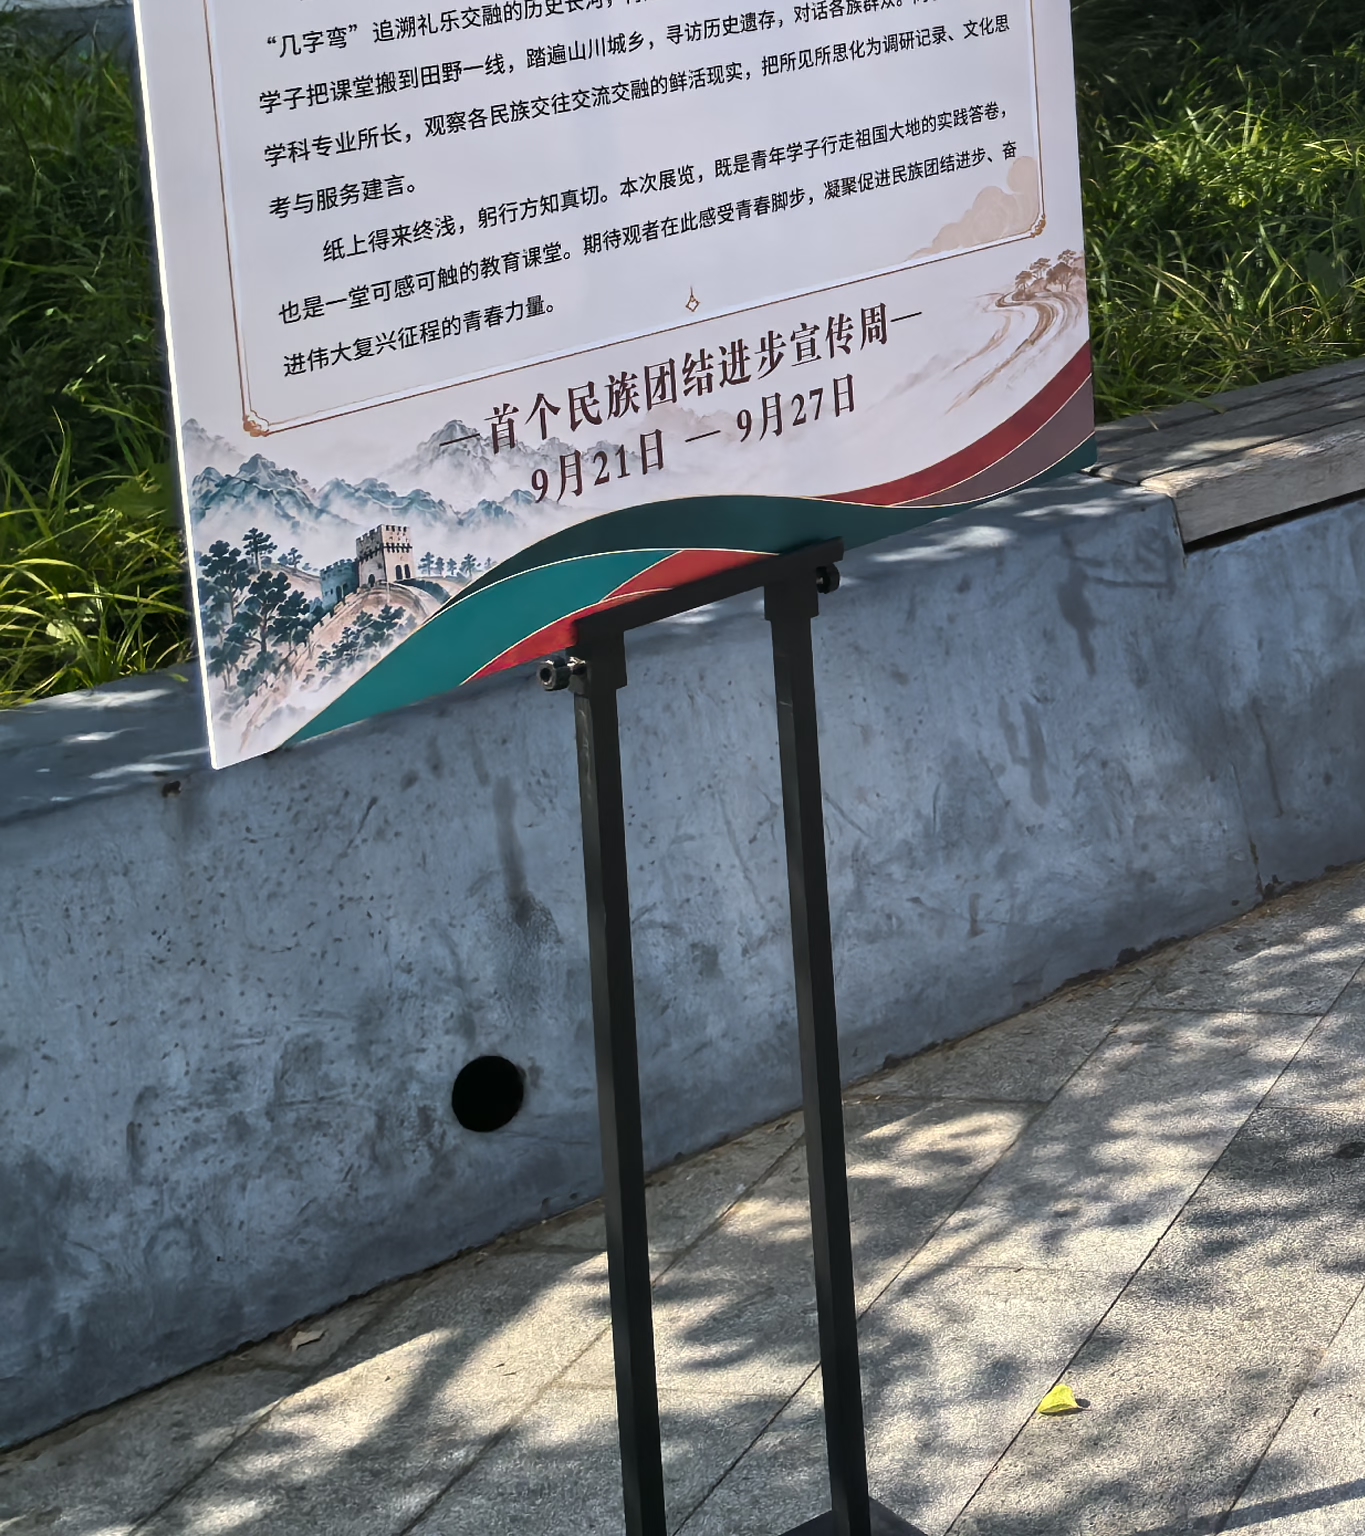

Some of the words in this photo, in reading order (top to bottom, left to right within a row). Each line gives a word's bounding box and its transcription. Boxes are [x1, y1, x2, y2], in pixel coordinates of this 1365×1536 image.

[264, 10, 1012, 171] 学科专业所长，观察各民族交往交流交融的鲜活现实，把所见所思化为调研记录、文化思
[268, 174, 417, 219] 考与服务建言。
[279, 138, 1018, 329] 也是一堂可感可触的教育课堂。期待观者在此感受青春脚步，凝聚促进民族团结进步、奋
[322, 101, 1006, 263] 纸上得来终浅，躬行方知真切。本次展览，既是青年学子行走祖国大地的实践答卷，
[283, 298, 559, 380] 进伟大复兴征程的青春力量。
